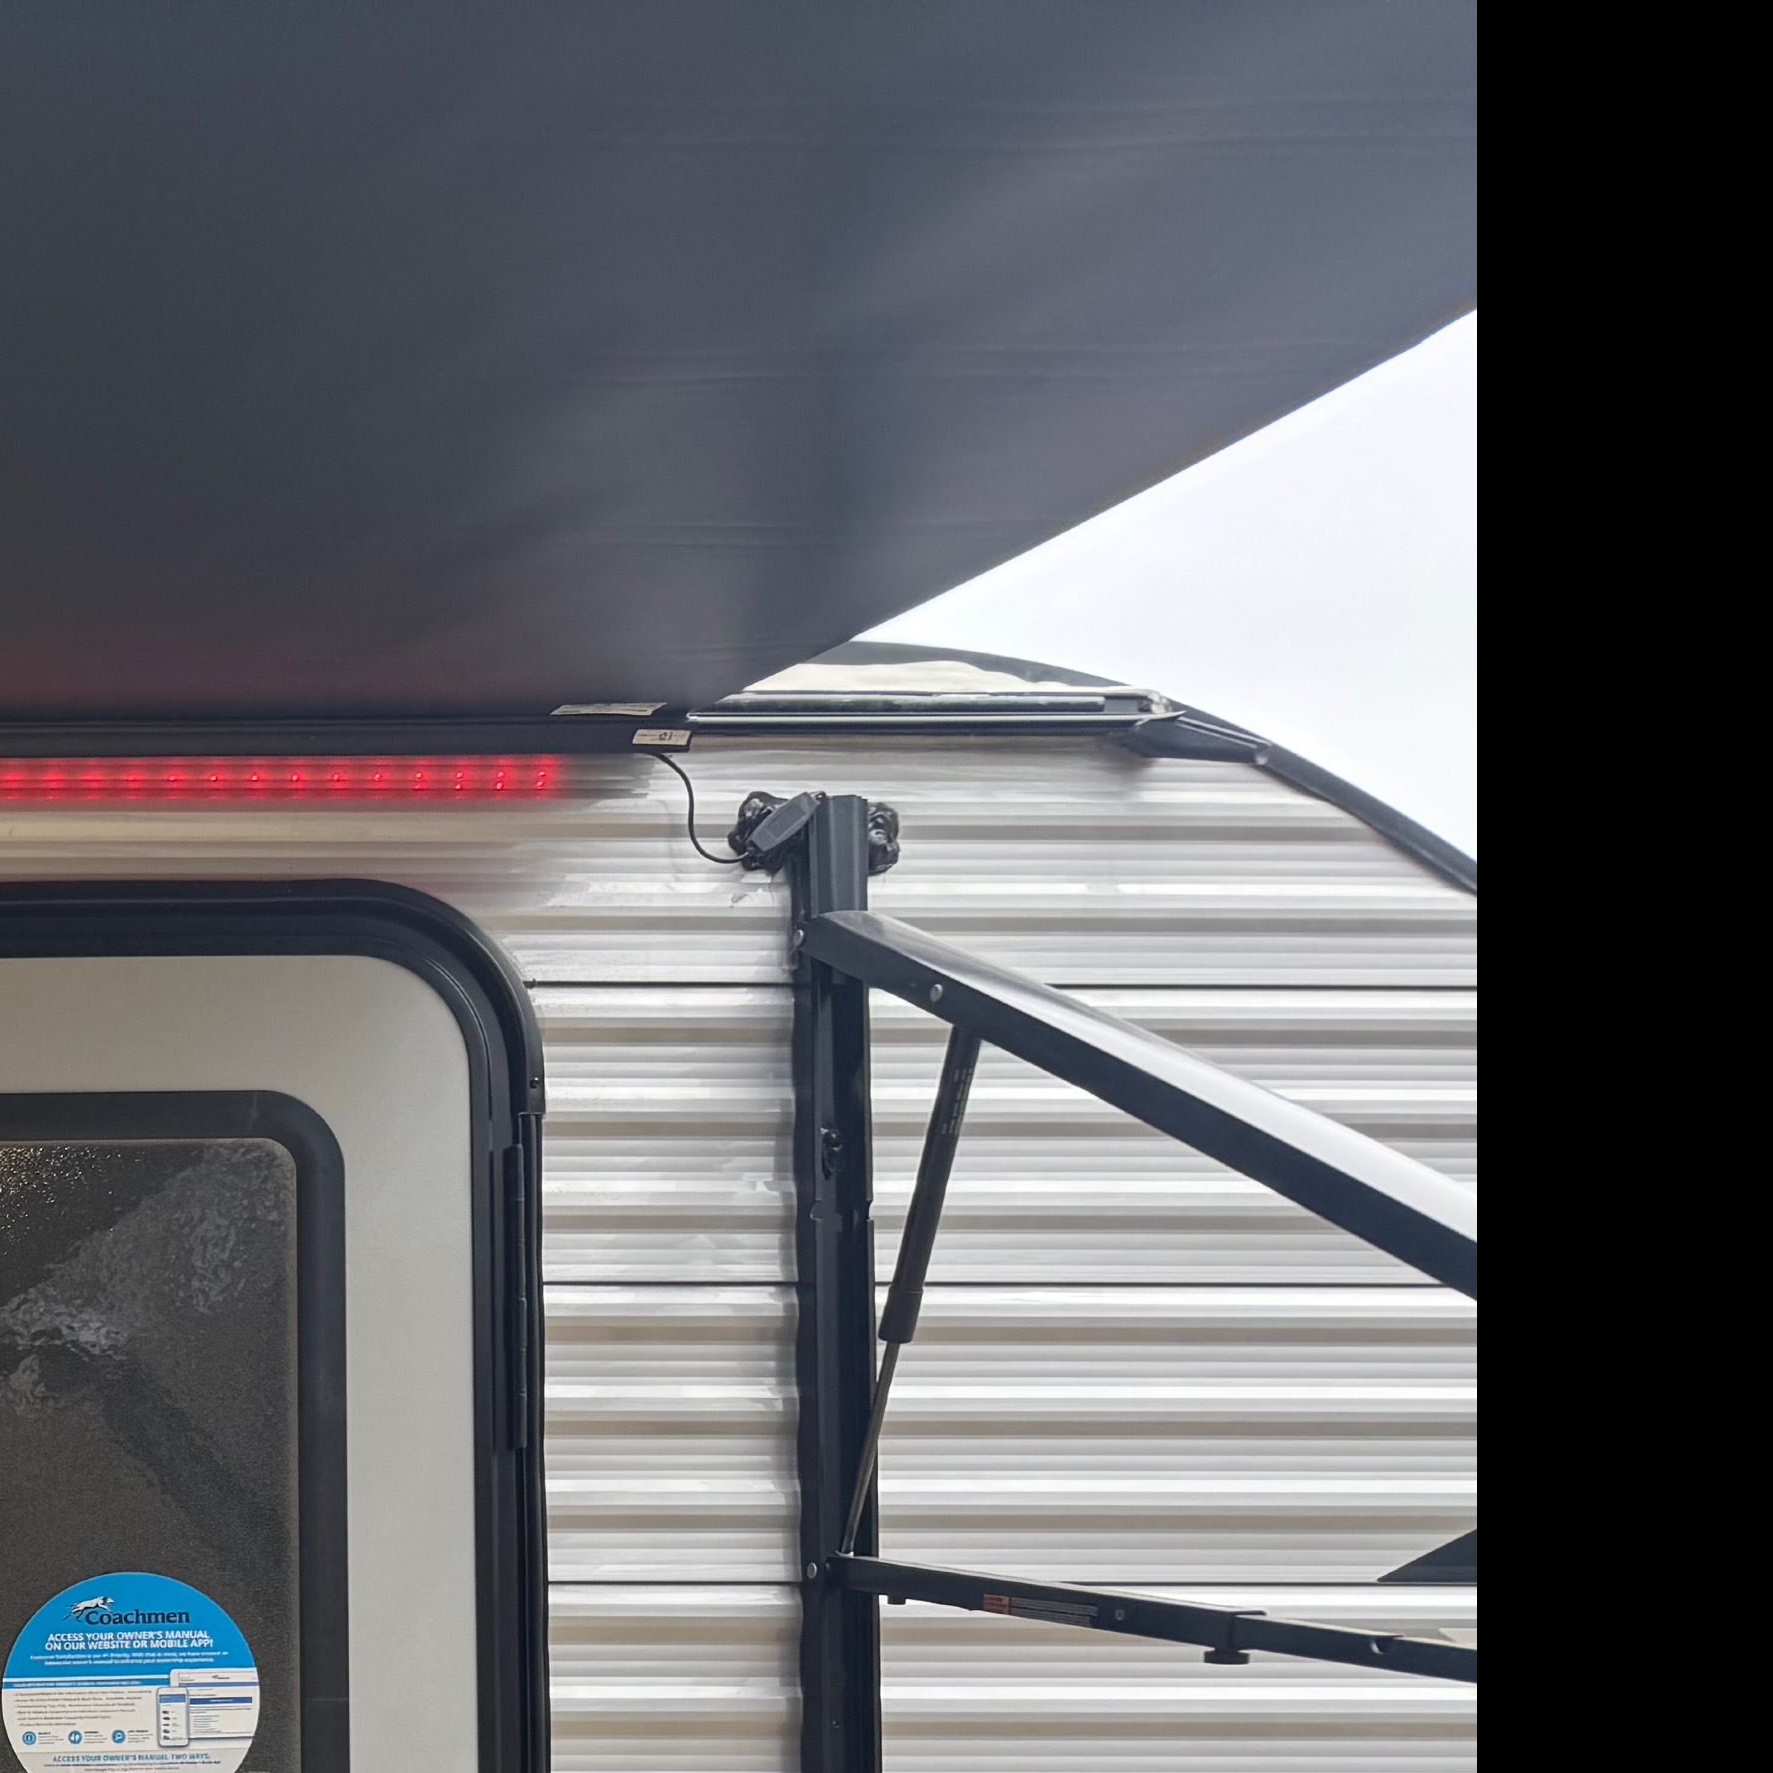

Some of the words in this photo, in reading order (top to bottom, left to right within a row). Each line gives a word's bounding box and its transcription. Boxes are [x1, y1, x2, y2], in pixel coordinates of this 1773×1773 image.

[85, 1609, 190, 1625] Coachmen
[47, 1633, 84, 1642] ACCESS
[86, 1632, 114, 1641] YOUR
[116, 1631, 162, 1640] OWNER'S
[165, 1630, 210, 1639] MANUAL
[45, 1642, 62, 1651] ON
[64, 1641, 86, 1650] OUR
[88, 1640, 131, 1649] WEBSITE
[132, 1640, 148, 1648] OR
[150, 1639, 189, 1648] MOBILE
